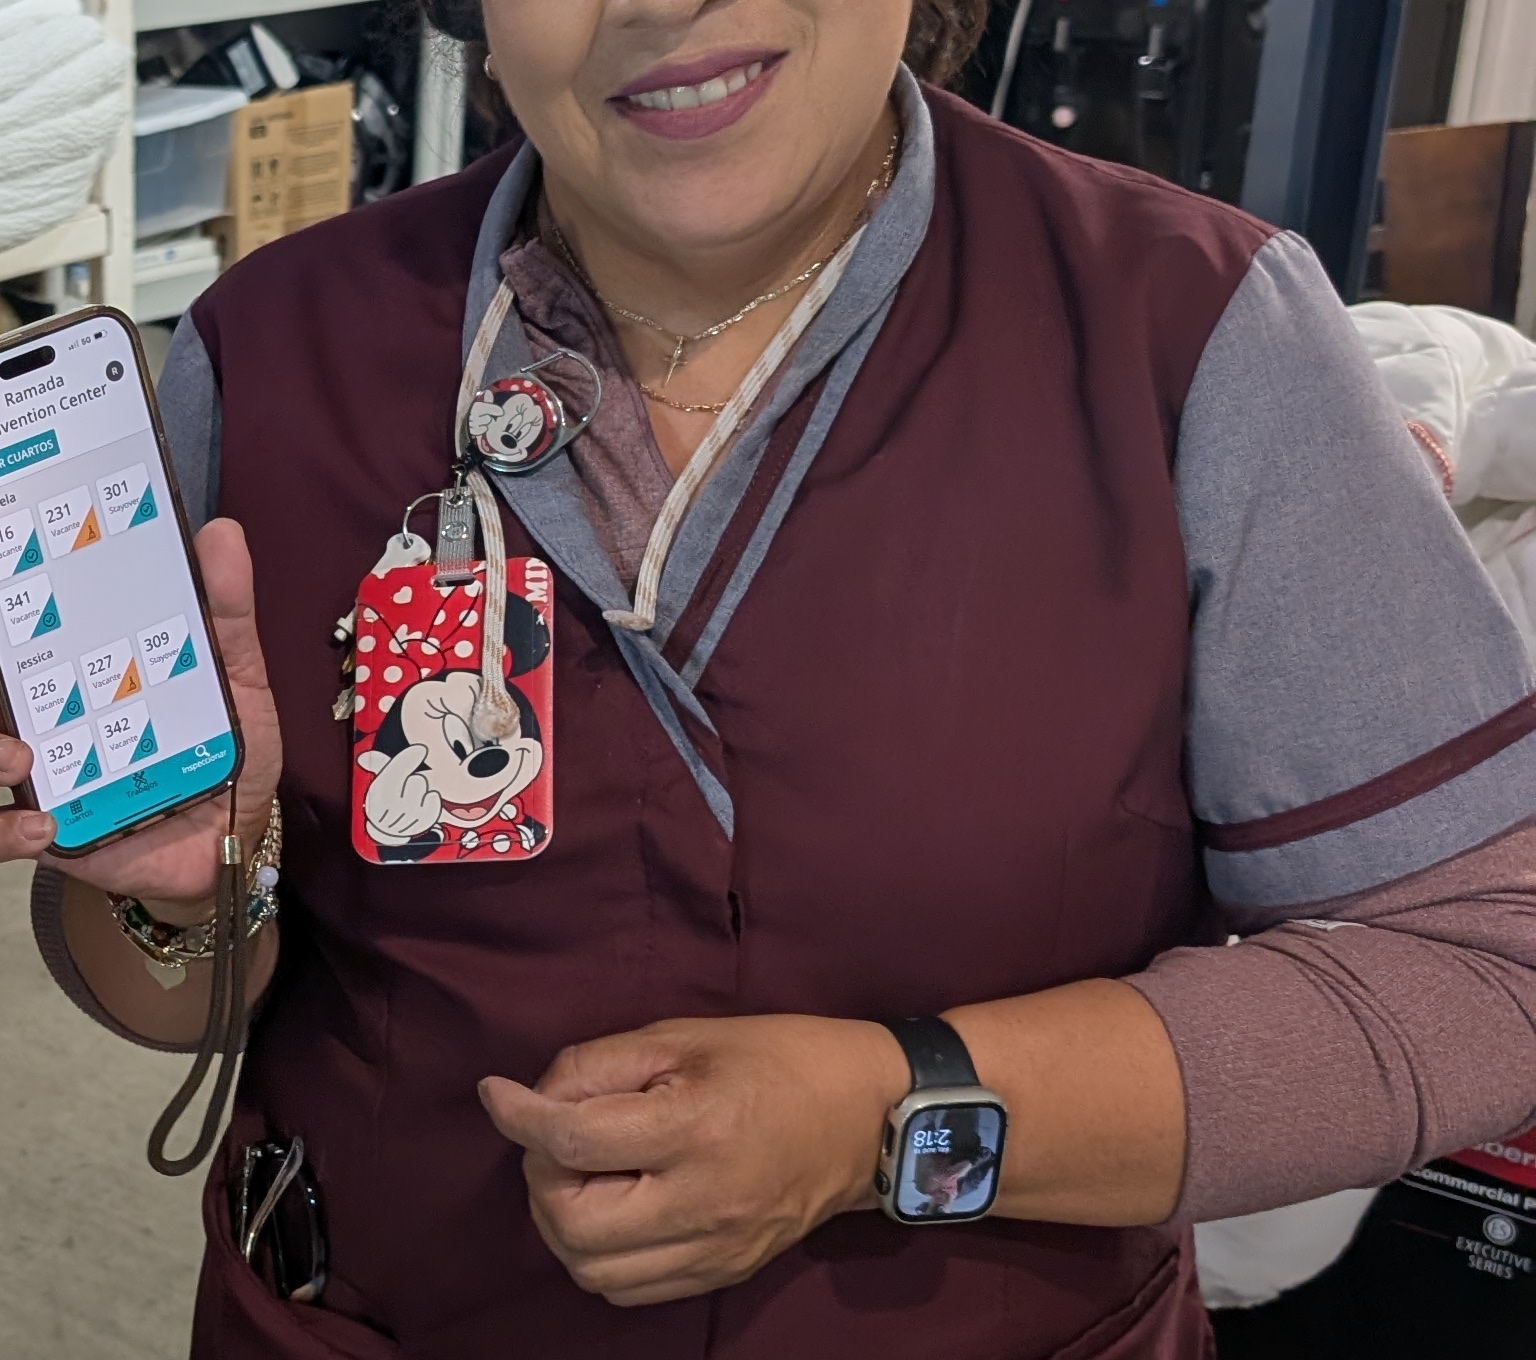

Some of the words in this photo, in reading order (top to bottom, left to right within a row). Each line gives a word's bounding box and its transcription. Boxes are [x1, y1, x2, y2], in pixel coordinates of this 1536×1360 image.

[110, 366, 119, 376] R
[4, 375, 65, 407] Ramada
[59, 383, 108, 411] Center
[7, 439, 54, 465] CUARTOS
[46, 503, 71, 524] 231
[103, 480, 129, 501] 301
[50, 520, 81, 538] Vacante
[109, 497, 140, 515] Stayover
[5, 591, 31, 612] 341
[10, 608, 40, 625] Vacante
[16, 649, 54, 673] Jessica
[30, 679, 57, 700] 226
[87, 655, 113, 676] 227
[144, 631, 170, 652] 309
[35, 697, 65, 714] Vacante
[92, 672, 122, 690] Vacante
[149, 647, 180, 666] Stayover
[47, 742, 74, 763] 329
[104, 718, 131, 739] 342
[52, 759, 82, 776] Vacante
[109, 734, 139, 752] Vacante
[64, 809, 94, 827] Cuartos
[181, 749, 227, 775] Inspeccionar
[914, 1129, 951, 1147] 2:18
[1455, 1236, 1532, 1273] EXECUTIVE
[1468, 1254, 1514, 1280] SERIES
